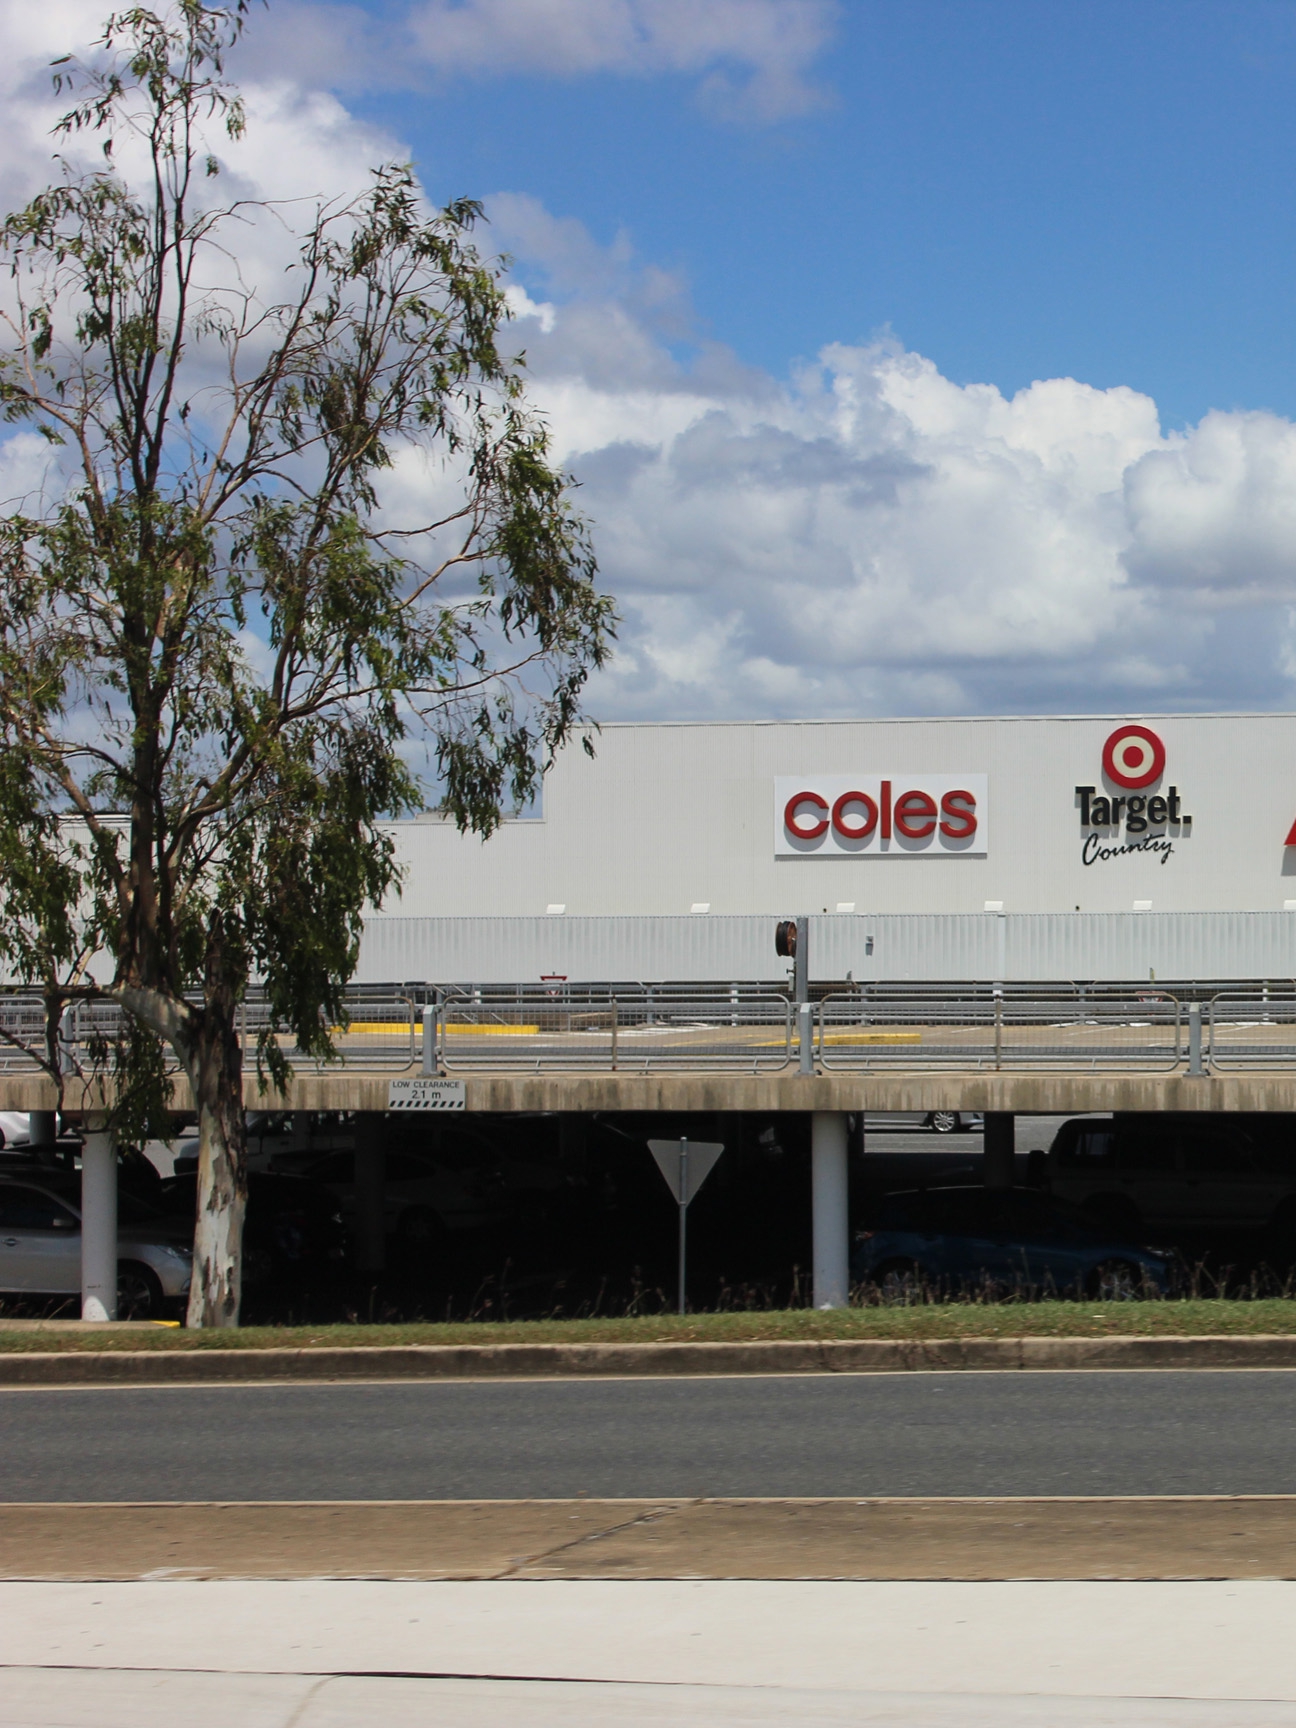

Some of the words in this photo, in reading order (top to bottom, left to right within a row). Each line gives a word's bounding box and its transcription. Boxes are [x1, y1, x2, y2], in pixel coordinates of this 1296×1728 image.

[784, 781, 978, 839] coles
[1082, 832, 1174, 866] Country
[392, 1081, 410, 1089] LOW
[413, 1081, 460, 1089] CLEARANCE
[431, 1091, 442, 1099] m
